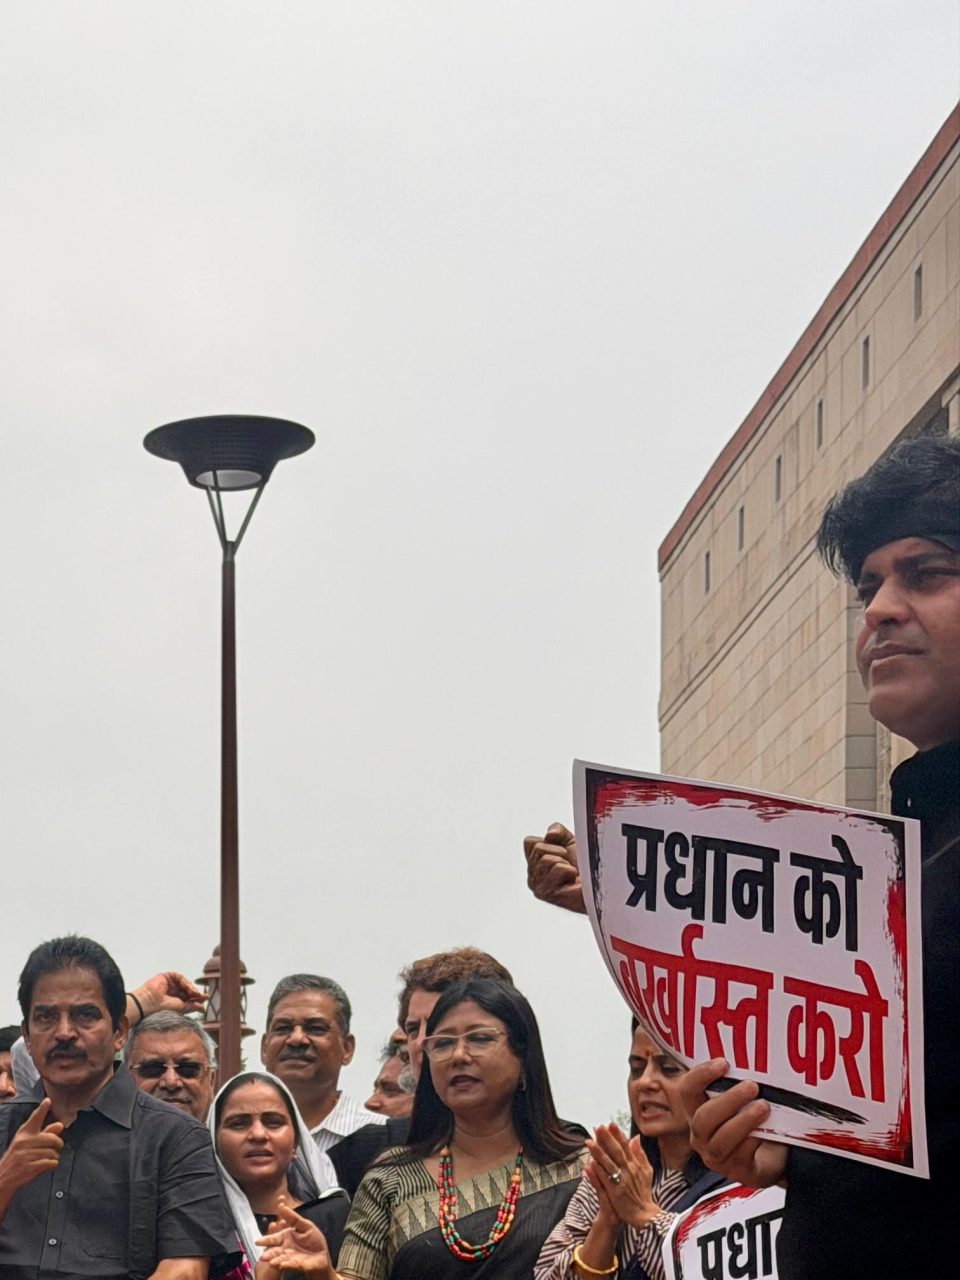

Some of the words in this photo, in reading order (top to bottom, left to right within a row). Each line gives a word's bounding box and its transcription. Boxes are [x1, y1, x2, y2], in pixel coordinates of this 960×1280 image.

[621, 823, 780, 933] प्रधान
[790, 834, 863, 952] को
[609, 923, 774, 1074] बर्खास्त
[783, 959, 889, 1103] करो
